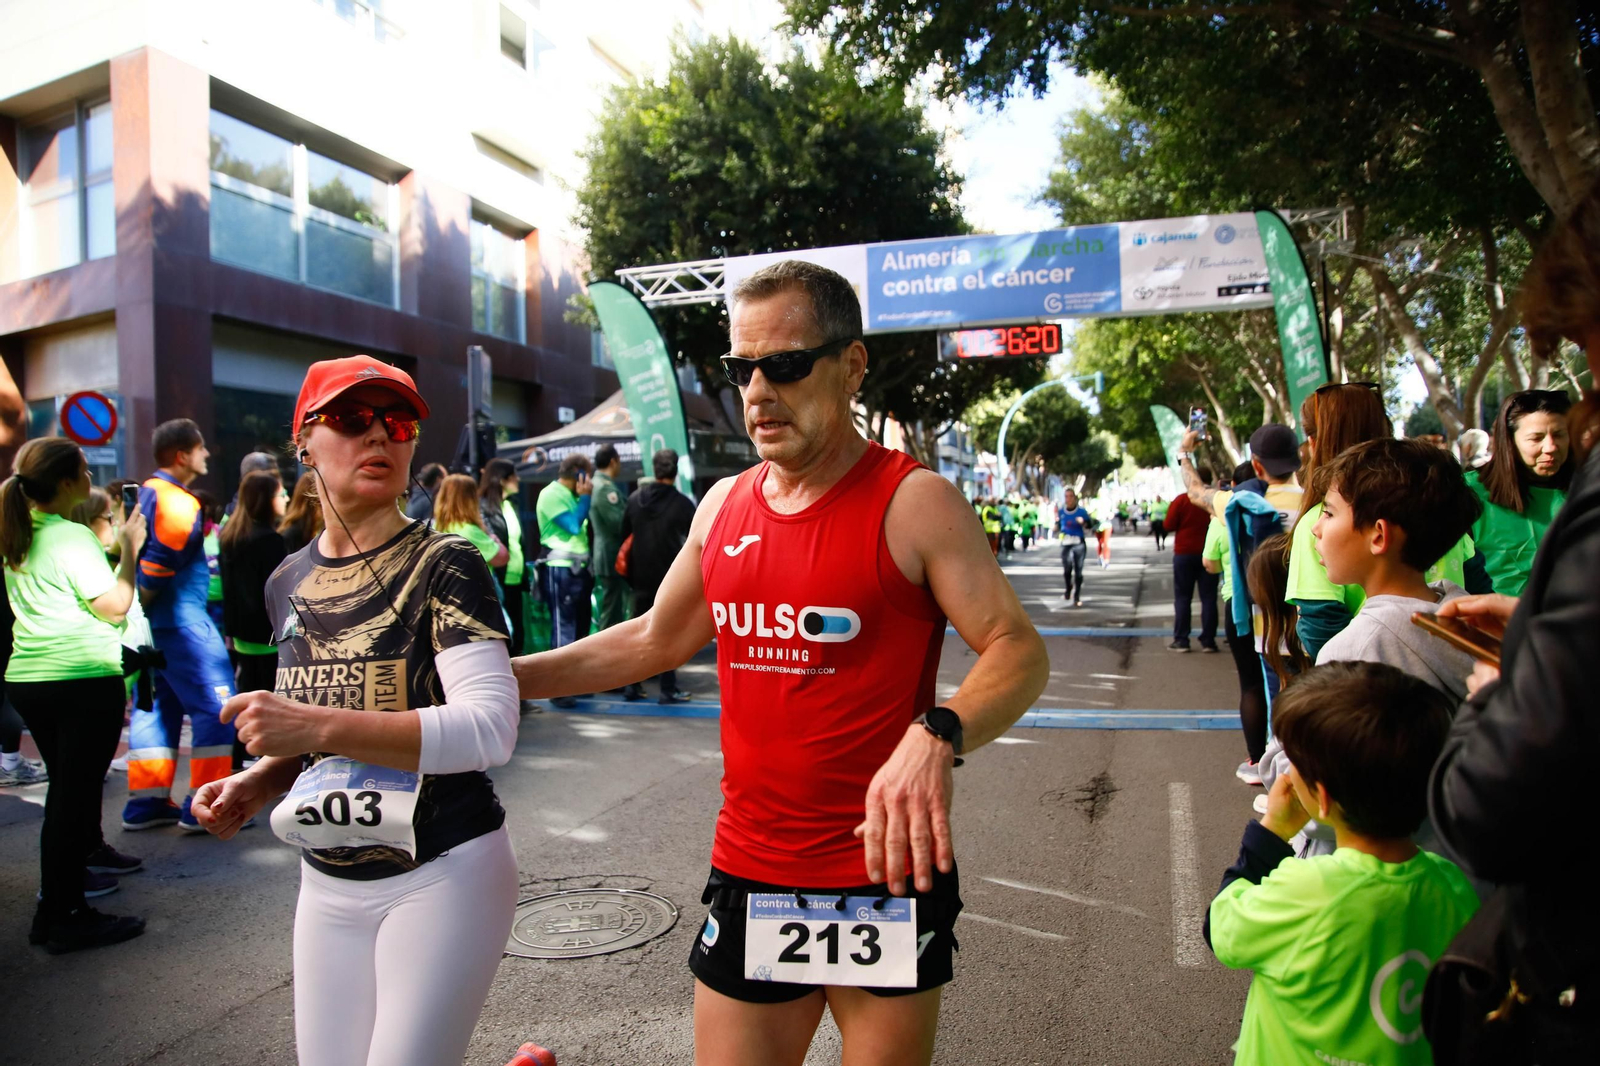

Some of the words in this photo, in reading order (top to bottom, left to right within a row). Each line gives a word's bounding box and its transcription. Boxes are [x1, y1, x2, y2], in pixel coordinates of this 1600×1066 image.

[882, 246, 971, 272] Almería
[882, 273, 957, 297] contra
[963, 269, 987, 290] el
[991, 266, 1076, 289] cáncer
[748, 646, 809, 662] RUNNING
[275, 662, 364, 690] UNNERS
[375, 663, 397, 707] TEAM
[295, 790, 383, 827] 503
[755, 900, 790, 909] contra
[807, 899, 836, 910] cánce
[777, 922, 882, 965] 213
